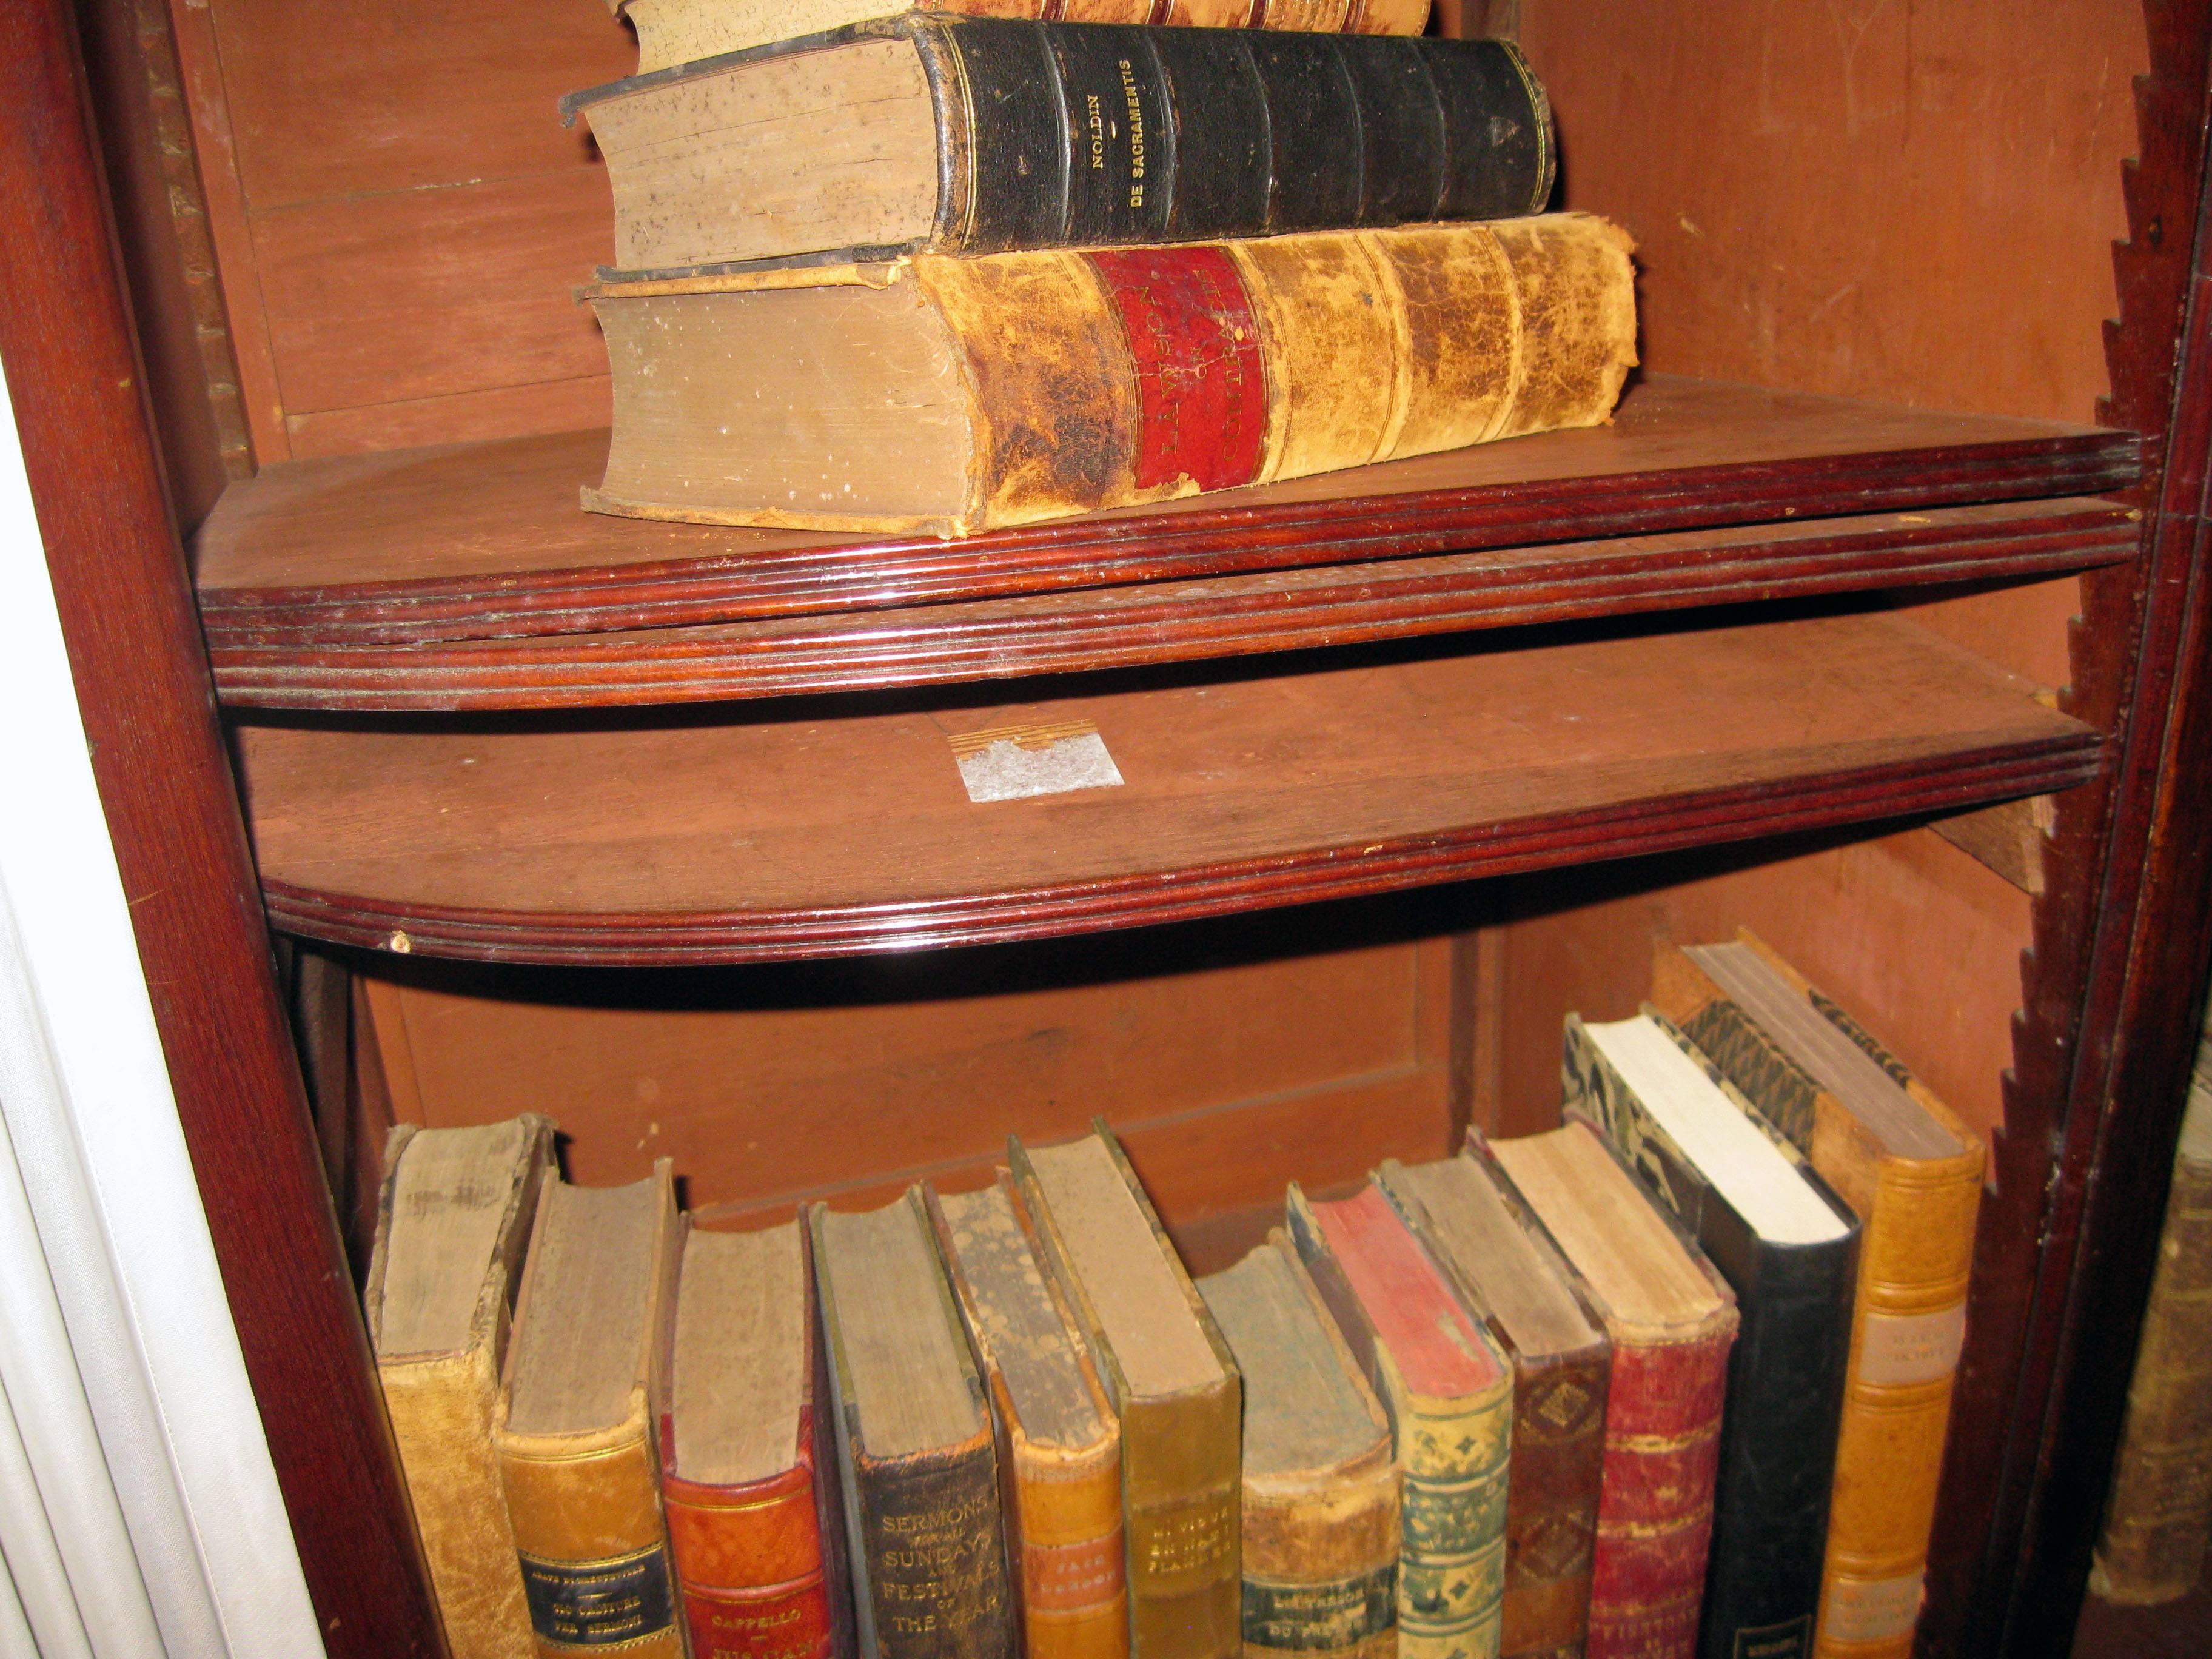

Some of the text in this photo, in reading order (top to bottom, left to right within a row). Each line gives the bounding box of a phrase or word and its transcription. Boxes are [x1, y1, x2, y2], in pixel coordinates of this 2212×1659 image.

[1087, 95, 1104, 169] NOLDIN
[1119, 59, 1144, 208] DE SACRAMENTIS
[1136, 286, 1178, 456] LAWSON
[1193, 269, 1241, 462] CONTRACTS
[882, 1497, 988, 1532] SERMONS
[711, 1609, 802, 1629] CAPPELLO
[892, 1614, 937, 1632] THE
